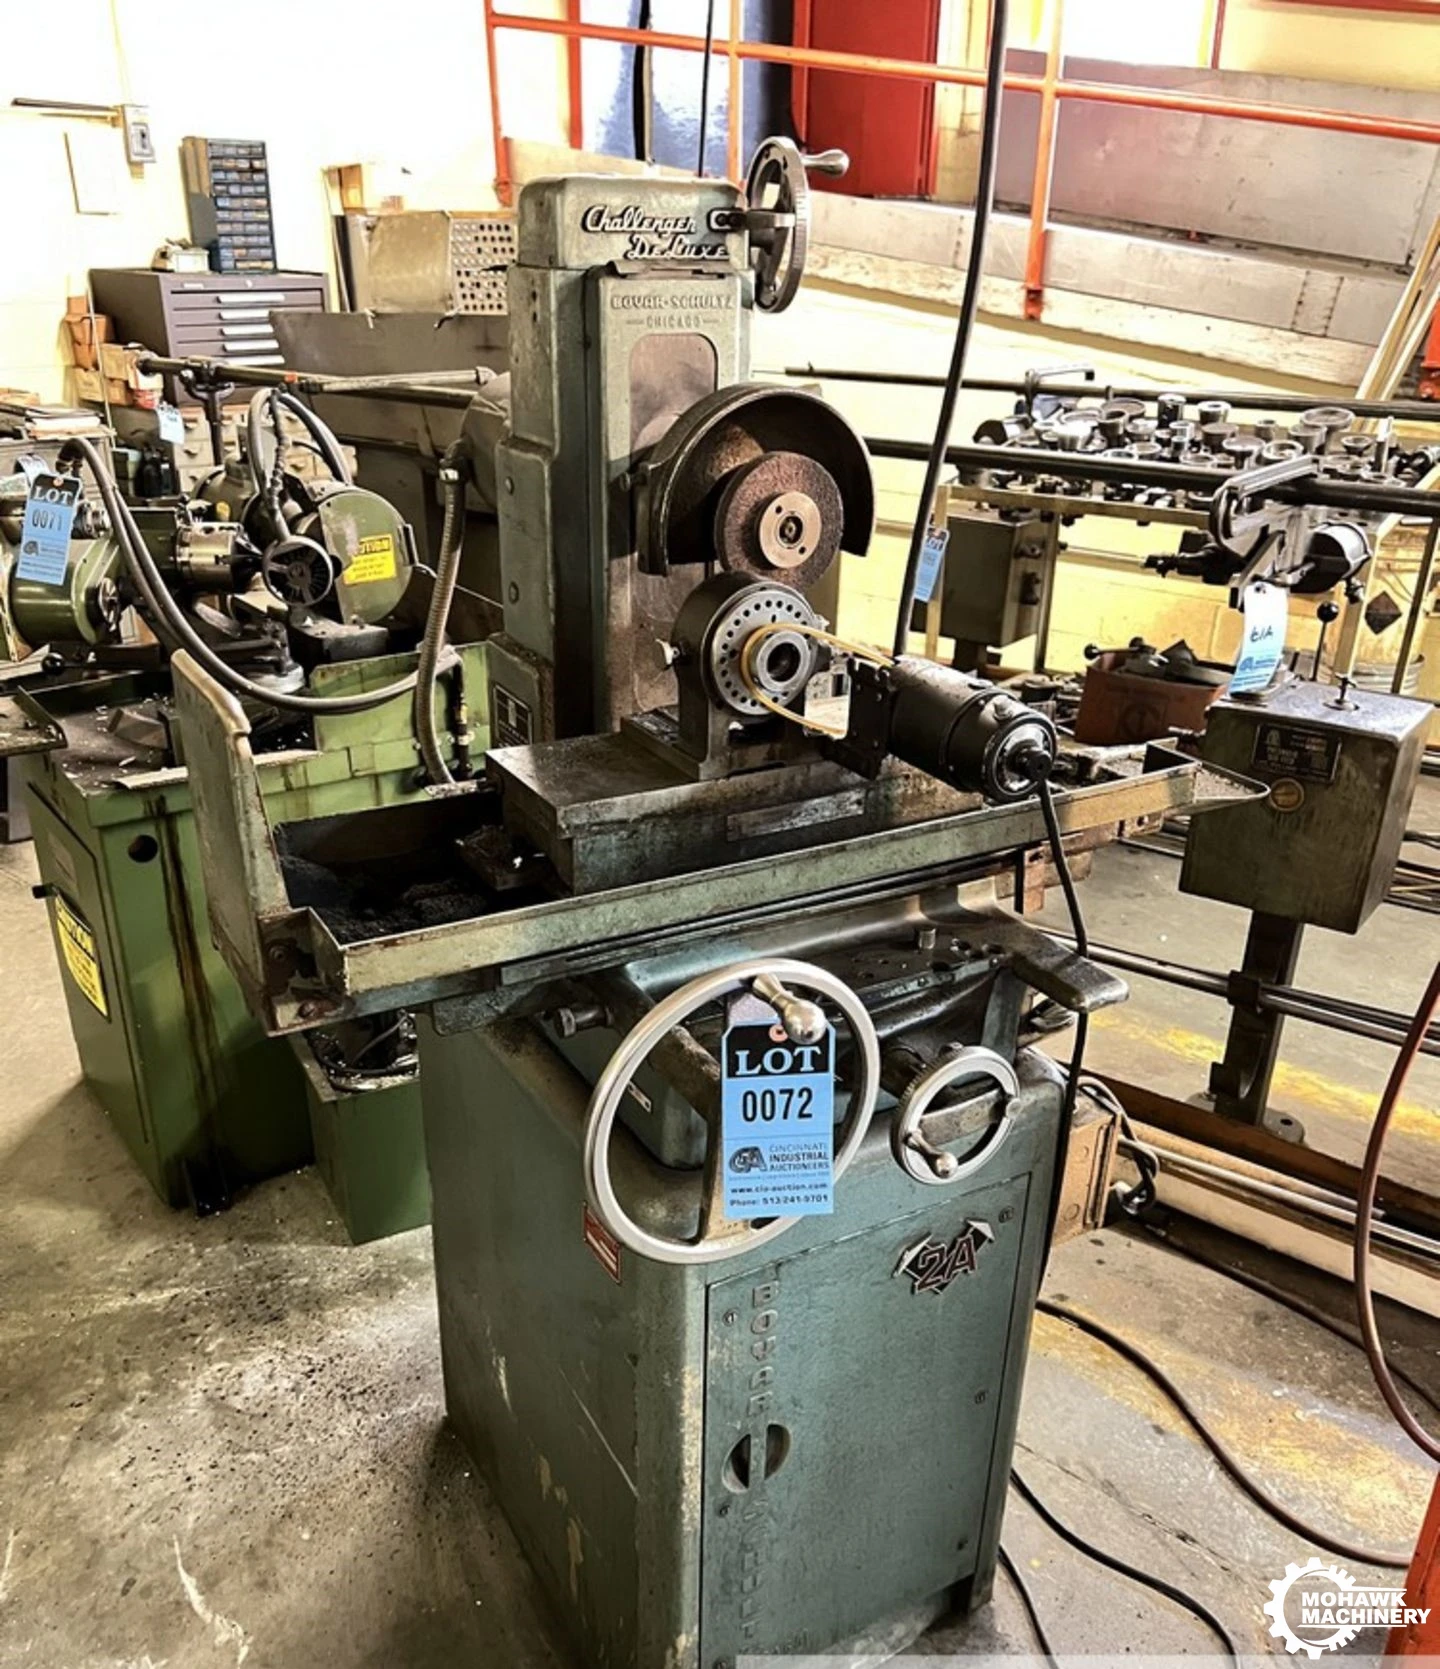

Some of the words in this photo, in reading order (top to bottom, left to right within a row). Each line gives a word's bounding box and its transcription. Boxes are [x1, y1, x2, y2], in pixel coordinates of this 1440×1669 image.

[581, 205, 696, 236] Challenger
[646, 316, 700, 328] CHICAGO
[34, 485, 73, 504] LOT
[735, 1046, 821, 1076] LOT
[742, 1087, 813, 1123] 0072
[769, 1142, 828, 1153] CINCINNATI
[769, 1151, 829, 1162] INDUSTRIAL
[769, 1162, 829, 1172] AUCTIONEERS
[915, 1234, 977, 1294] 2A
